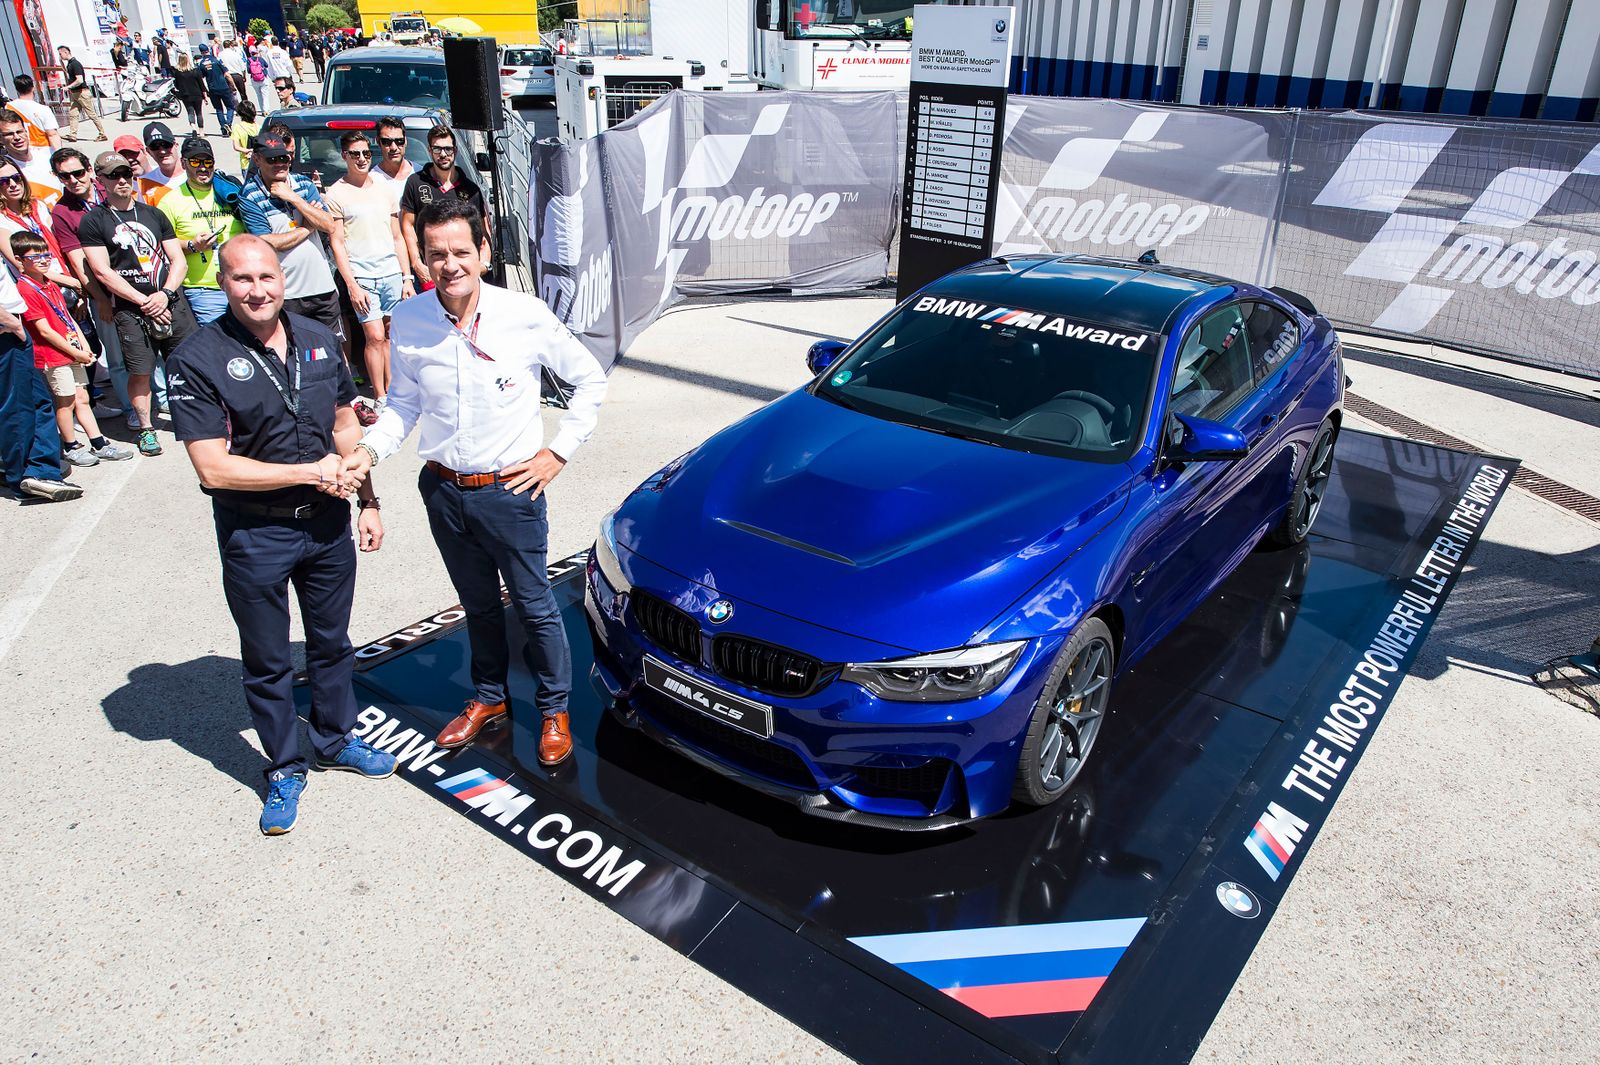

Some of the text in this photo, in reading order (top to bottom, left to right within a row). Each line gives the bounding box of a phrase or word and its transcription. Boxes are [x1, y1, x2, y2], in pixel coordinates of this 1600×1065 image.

[918, 47, 935, 55] BMW
[942, 49, 967, 57] AWARD.
[918, 55, 935, 63] BEST
[935, 56, 969, 65] QUALIFIER
[418, 184, 434, 204] 3
[913, 296, 987, 319] BMW
[1039, 317, 1148, 351] Award
[1442, 520, 1474, 543] IN
[1449, 498, 1487, 528] THE
[1411, 535, 1466, 594] LETTER
[355, 603, 467, 659] ORLD
[1355, 589, 1438, 688] POWERFUL
[712, 702, 744, 720] CS
[1316, 673, 1383, 752] MOST
[1281, 738, 1346, 802] THE
